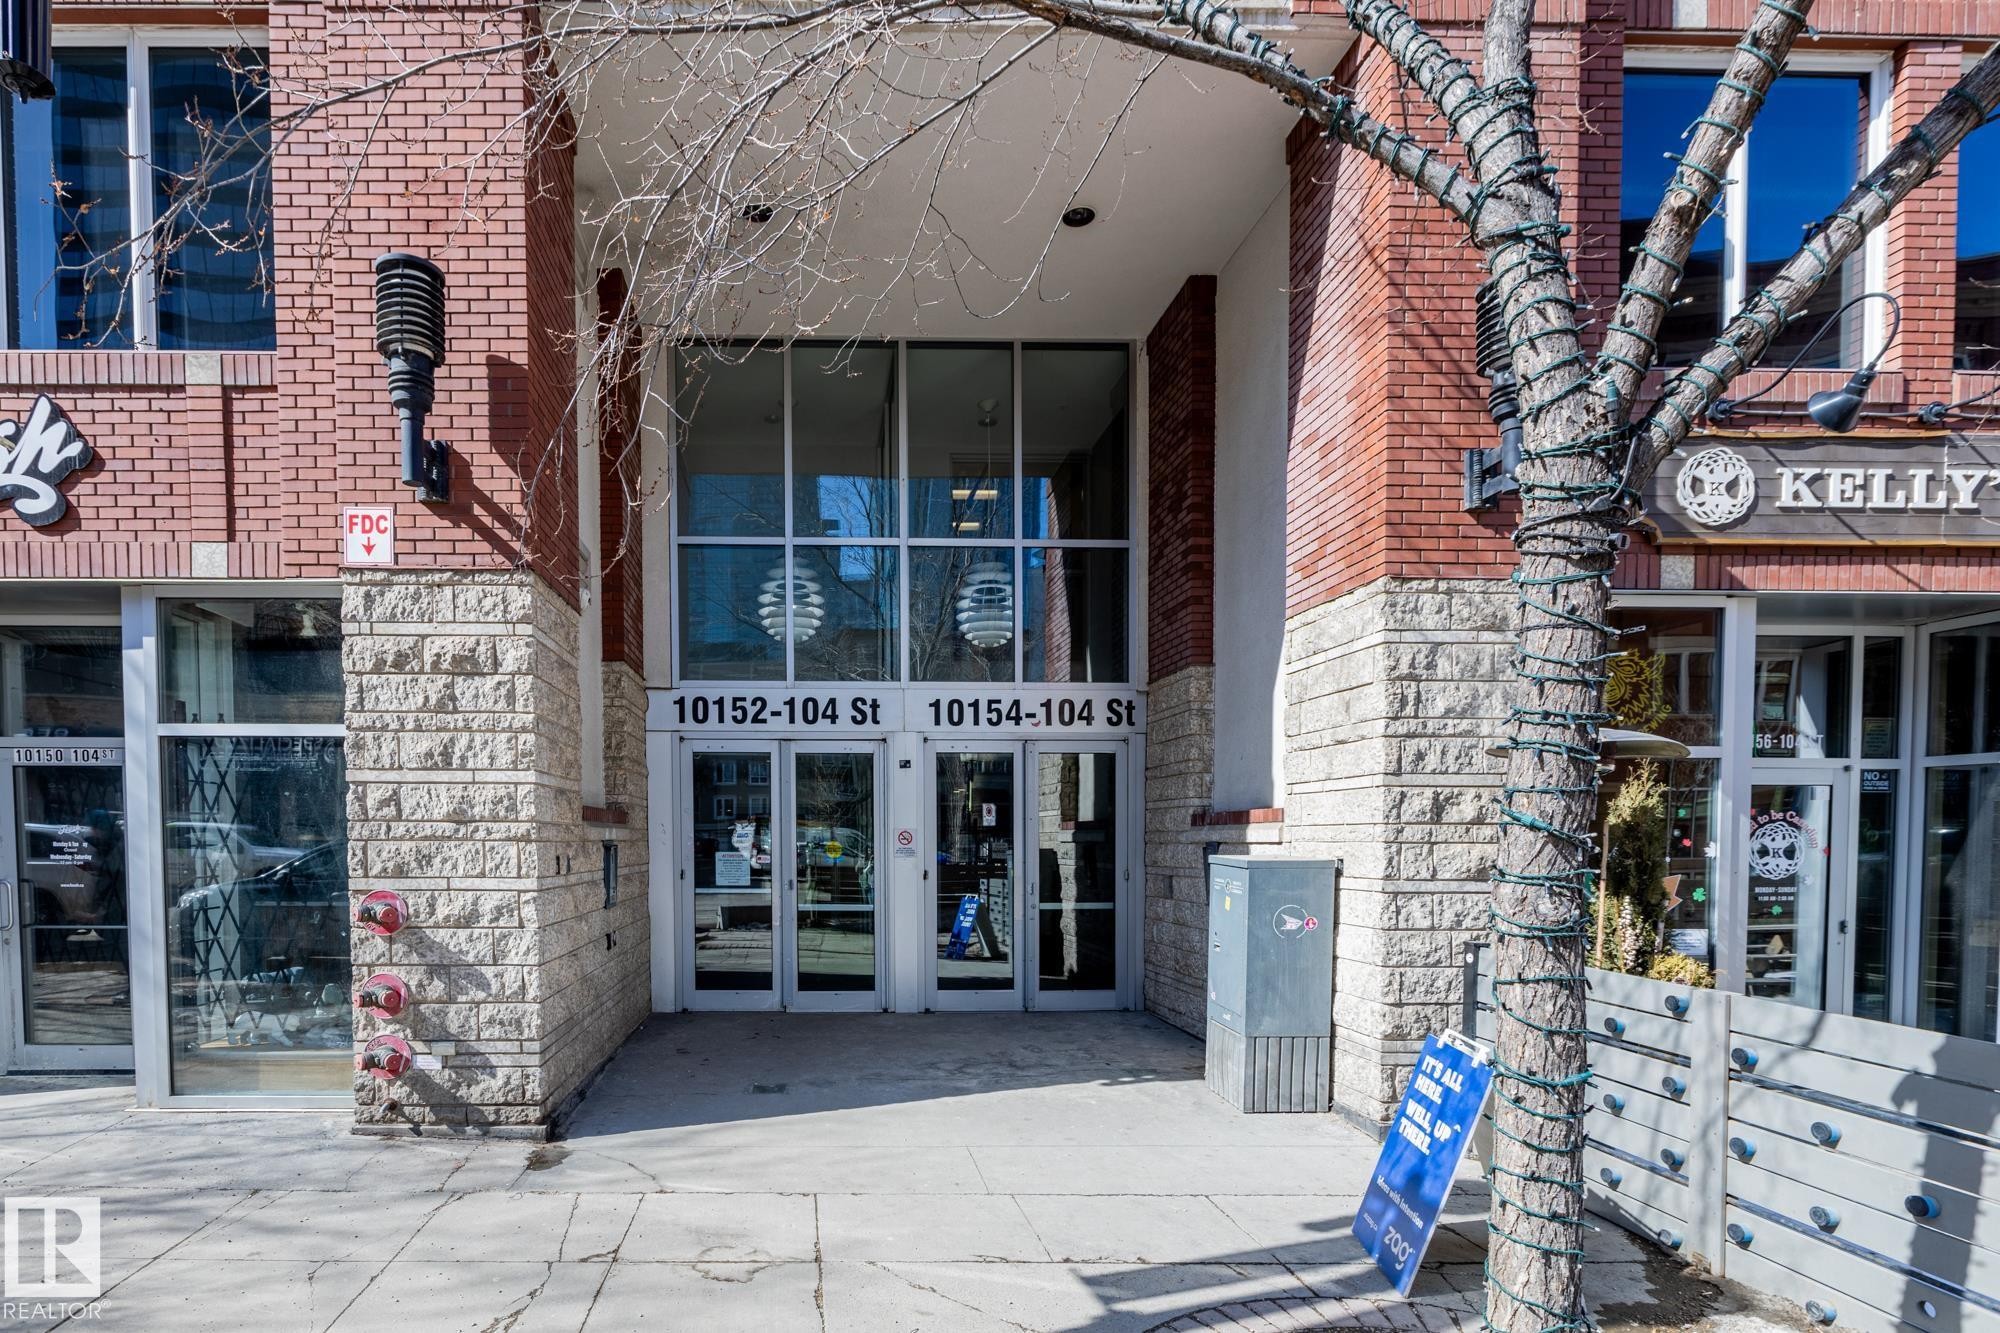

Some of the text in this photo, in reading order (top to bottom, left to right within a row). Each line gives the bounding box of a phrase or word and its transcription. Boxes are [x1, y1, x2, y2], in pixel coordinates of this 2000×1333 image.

[348, 514, 388, 534] FDC
[673, 697, 880, 726] 10152-104 St
[928, 698, 1136, 727] 10154-104 St
[16, 749, 115, 762] 10150 104 ST
[1864, 772, 1880, 780] NO
[1770, 810, 1784, 820] be
[1421, 1055, 1464, 1093] IT'S ALL
[1433, 1119, 1452, 1142] UP
